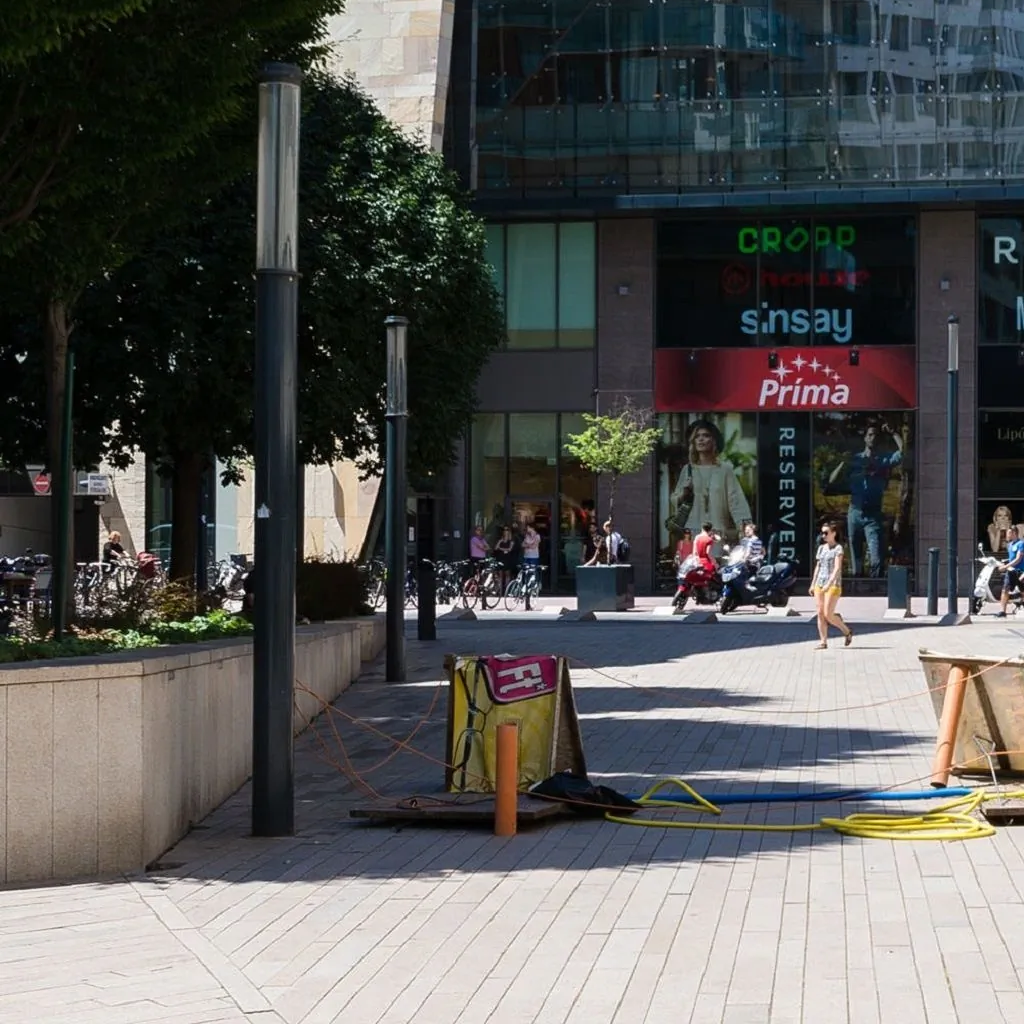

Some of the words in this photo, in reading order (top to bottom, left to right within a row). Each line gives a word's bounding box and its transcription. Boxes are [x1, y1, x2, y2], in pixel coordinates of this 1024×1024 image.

[738, 225, 856, 254] CROPP
[740, 301, 853, 343] sinsay
[778, 427, 796, 561] RESERVED
